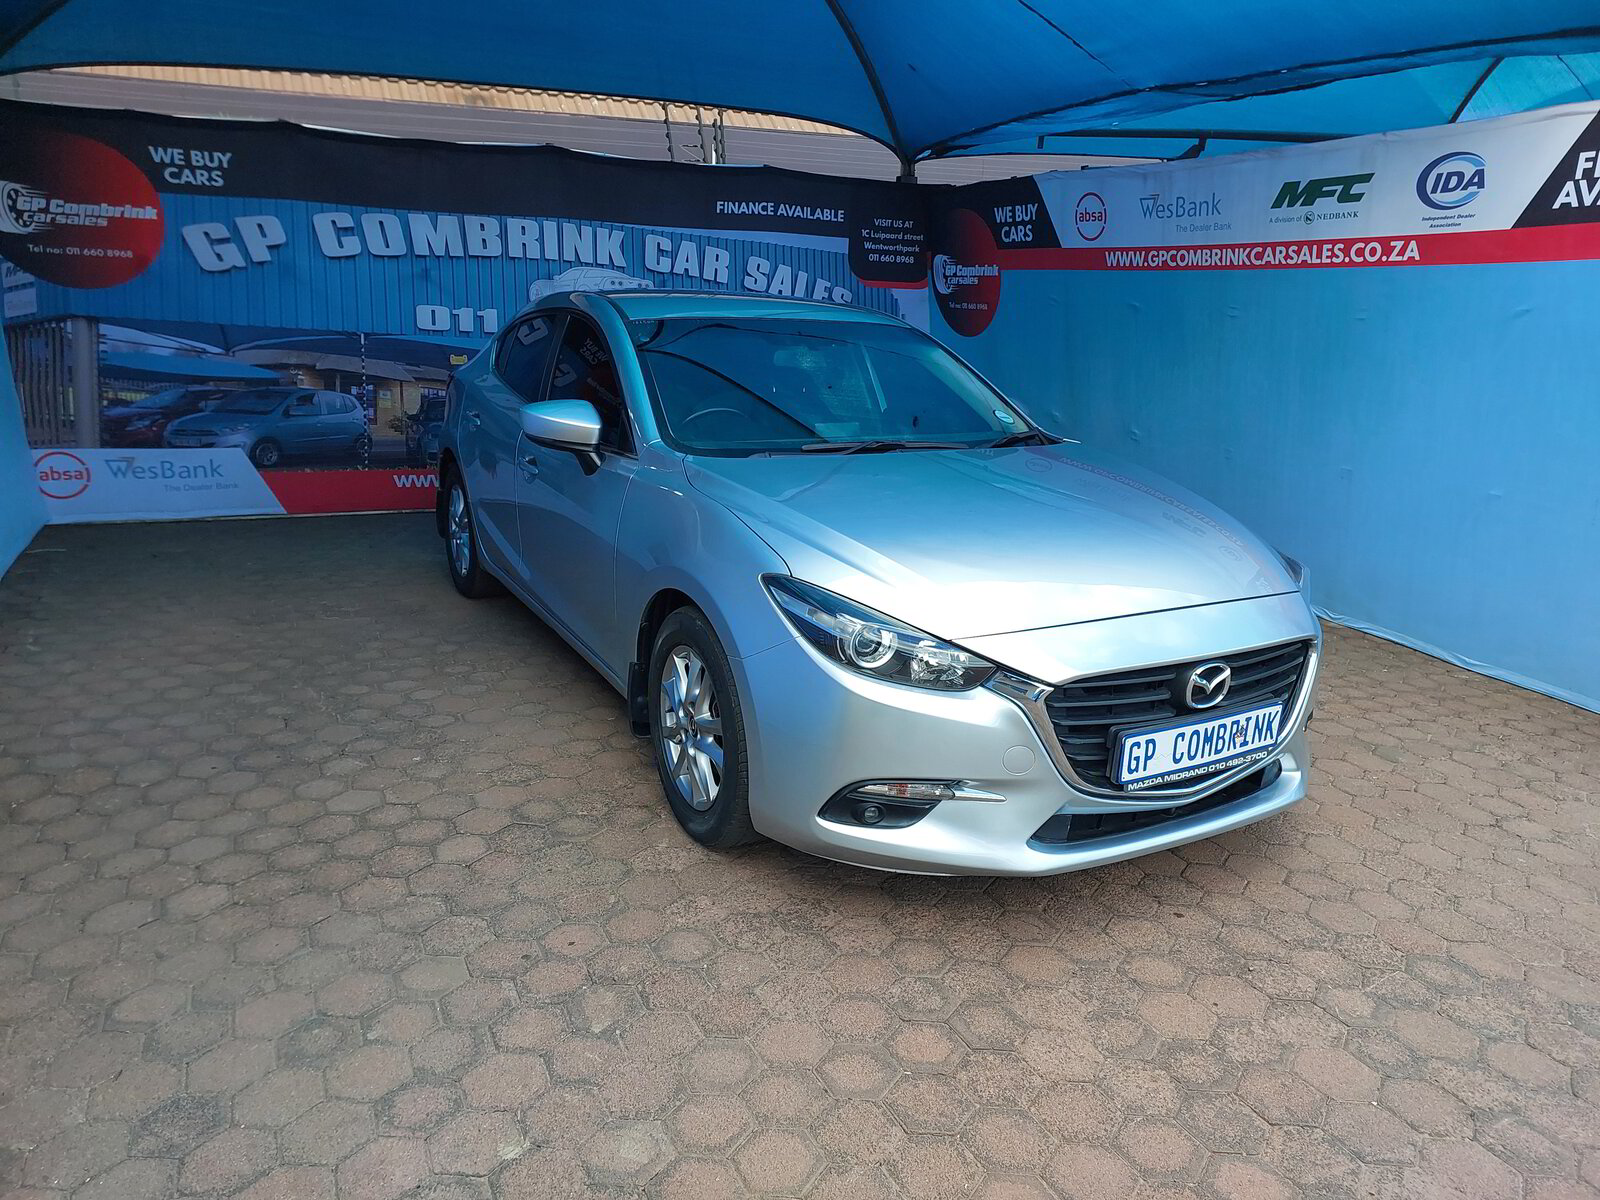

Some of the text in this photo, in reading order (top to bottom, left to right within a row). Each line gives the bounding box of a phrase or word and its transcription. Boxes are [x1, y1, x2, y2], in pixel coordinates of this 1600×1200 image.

[148, 145, 232, 168] WE BUY
[164, 167, 224, 187] CARS
[1430, 168, 1485, 195] IDA
[1270, 172, 1375, 209] MFC
[1552, 179, 1600, 210] AV
[16, 195, 157, 220] GP Combrink
[715, 200, 845, 222] FINANCE AVAILABLE
[994, 203, 1038, 223] WE BUY
[1078, 207, 1103, 223] absa
[1139, 193, 1221, 219] WesBank
[23, 212, 108, 227] carsales
[874, 218, 914, 229] VISIT US AT
[1175, 222, 1232, 233] The Dealer Bank
[1274, 216, 1295, 224] division
[1296, 215, 1303, 223] of
[1316, 211, 1359, 221] NEDBANK
[870, 230, 901, 241] Luipaard
[903, 232, 924, 241] street
[1001, 225, 1033, 243] CARS
[28, 244, 44, 253] Tel
[66, 247, 81, 255] 011
[83, 248, 105, 257] 660
[107, 249, 134, 259] 8968
[182, 214, 287, 272] GP
[312, 211, 626, 268] COMBRINK
[643, 233, 730, 283] CAR
[864, 240, 920, 253] Wentworthpark
[1105, 240, 1420, 268] WWW.GPCOMBRINKCARSALES.CO.ZA
[868, 253, 914, 264] 011 660 8968
[945, 265, 956, 276] GP
[947, 276, 979, 285] carsales
[415, 304, 498, 334] 011
[39, 467, 85, 482] absa
[105, 458, 224, 480] WesBank
[163, 483, 182, 491] The
[216, 482, 239, 491] Bank
[1127, 711, 1280, 775] GP COMBRINK
[1127, 751, 1268, 791] MAZDA MIDRAND 010 492-3700
